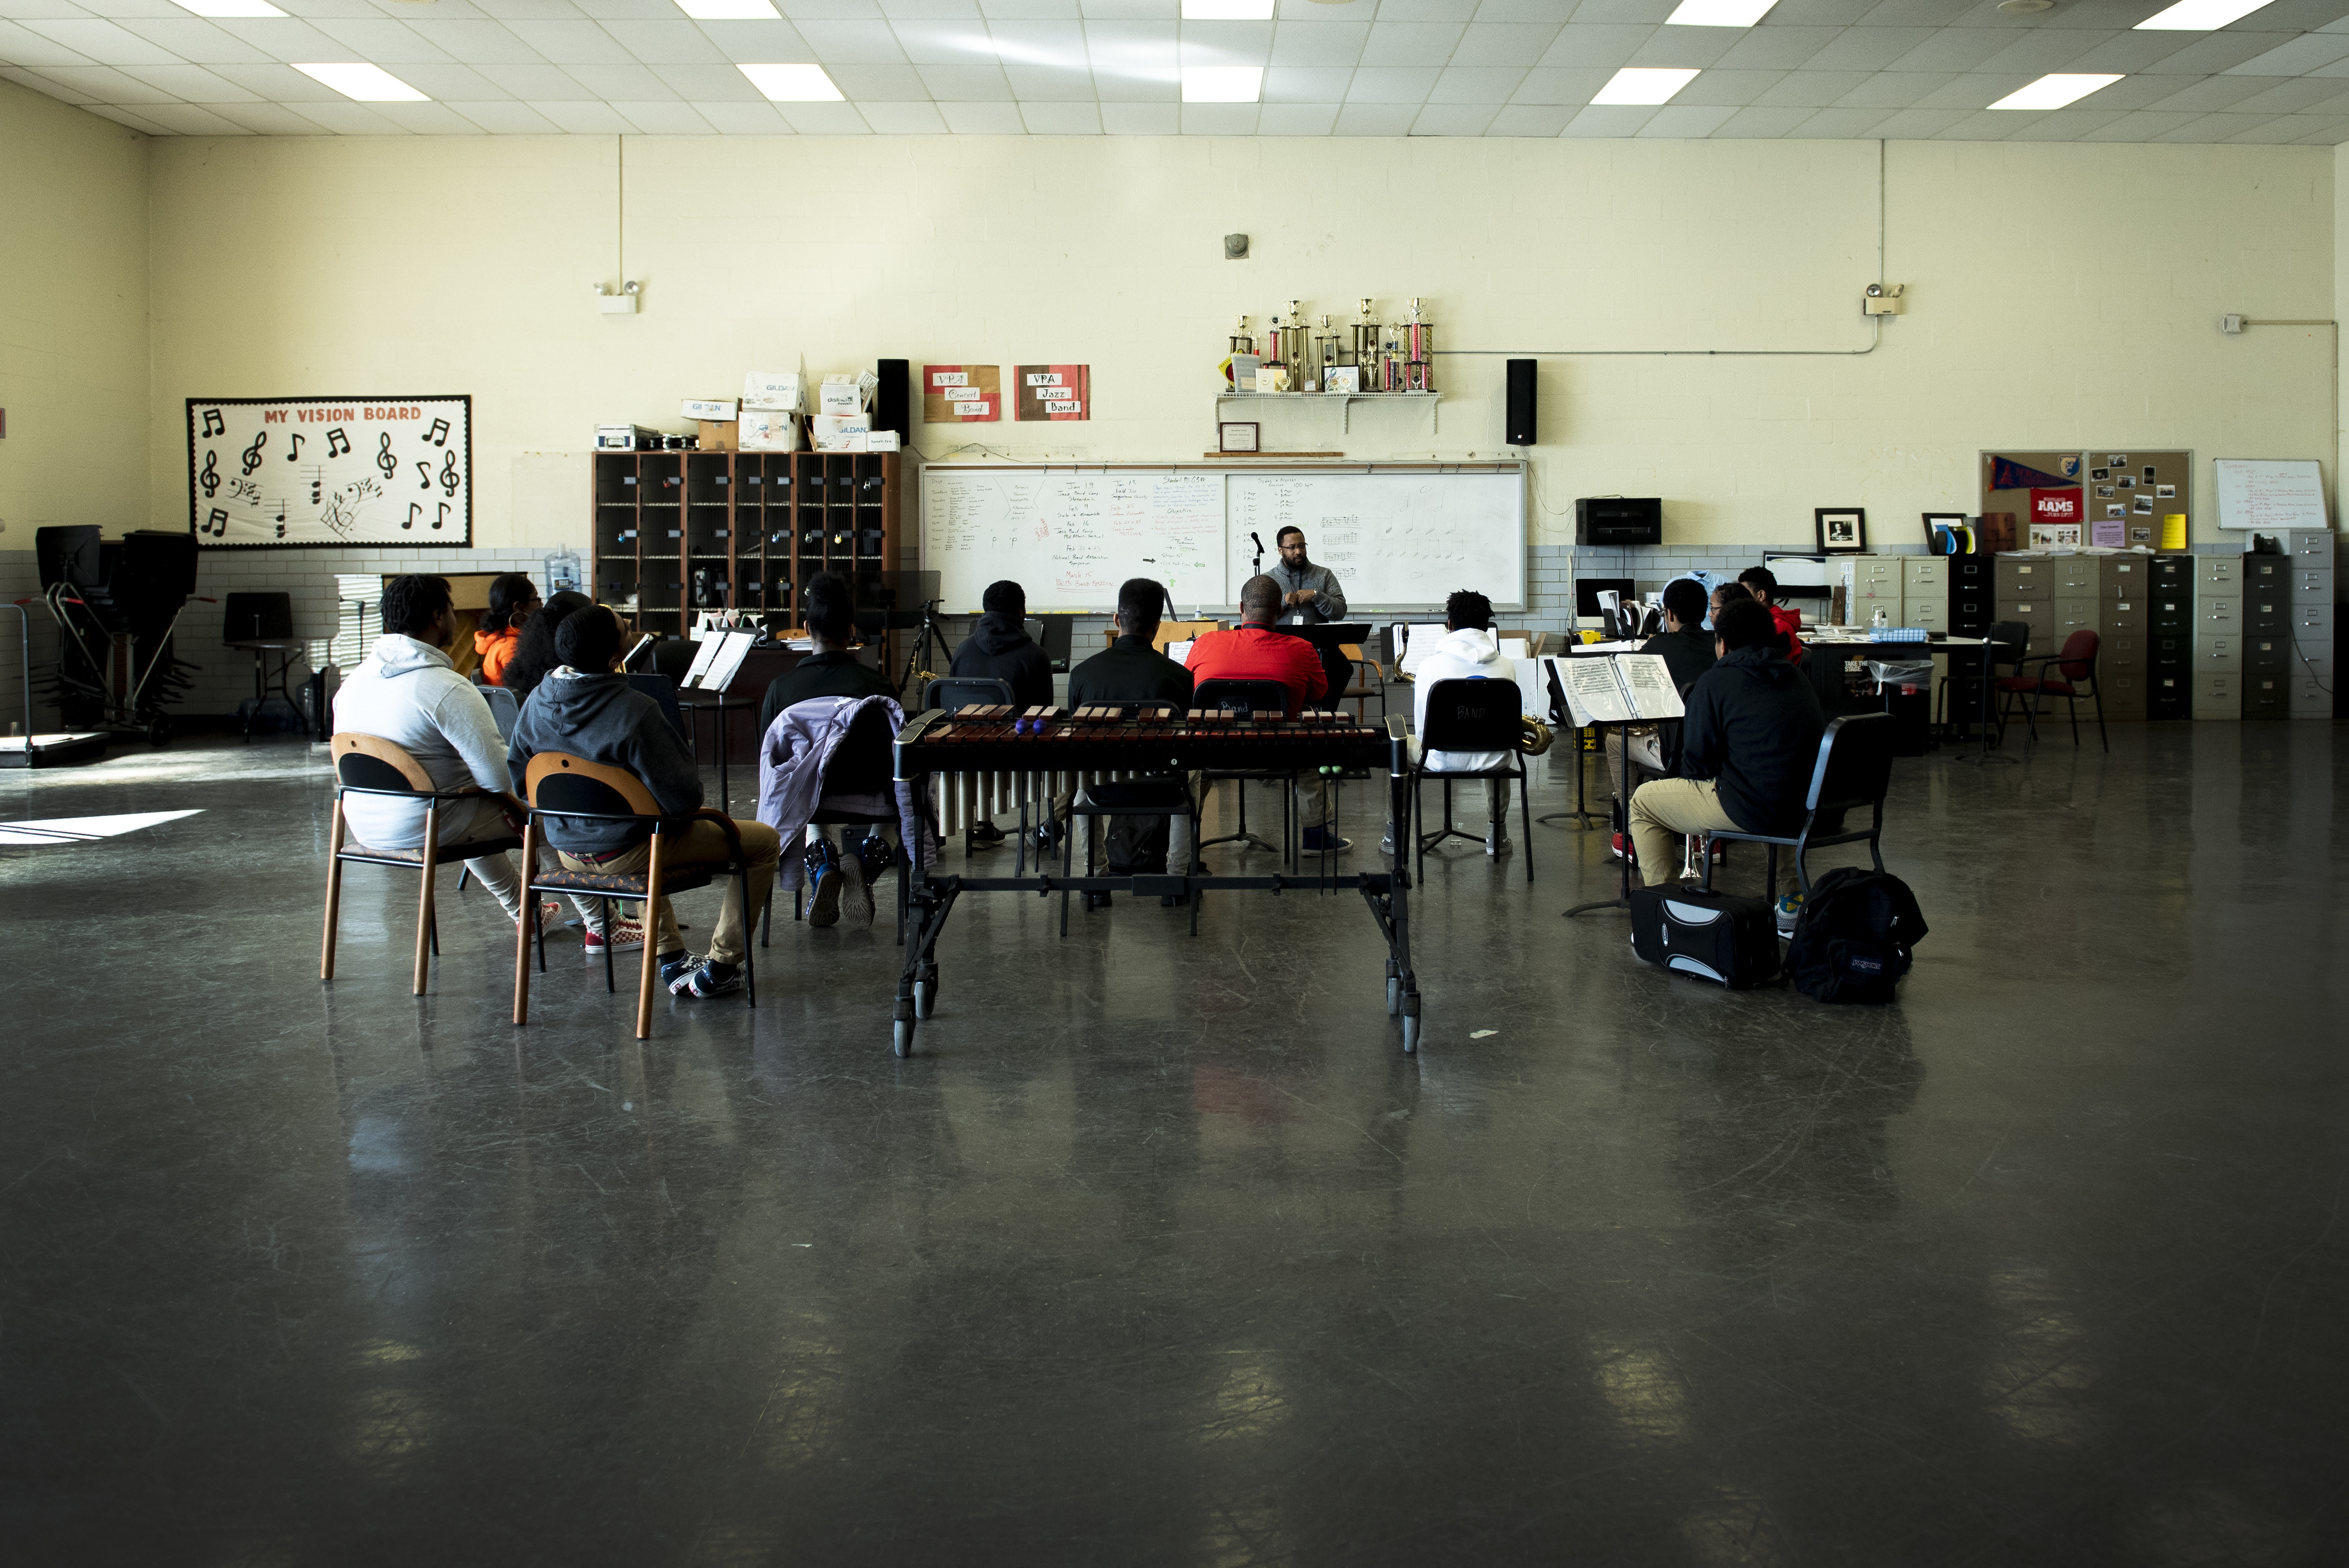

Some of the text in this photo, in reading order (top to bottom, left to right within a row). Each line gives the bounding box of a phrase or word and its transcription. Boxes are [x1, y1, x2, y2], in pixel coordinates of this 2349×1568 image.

[936, 375, 964, 384] VPA
[1033, 375, 1055, 384] VPA
[948, 389, 979, 399] Concert
[1042, 389, 1066, 399] Jazz
[961, 403, 983, 413] Band
[1051, 402, 1075, 411] Band
[264, 407, 421, 424] MY VISION BOARD
[2038, 500, 2074, 512] RAMS
[1066, 571, 1081, 579] March
[1221, 701, 1248, 713] Band
[1457, 706, 1486, 719] BAND
[1852, 959, 1881, 969] JANSPORT
